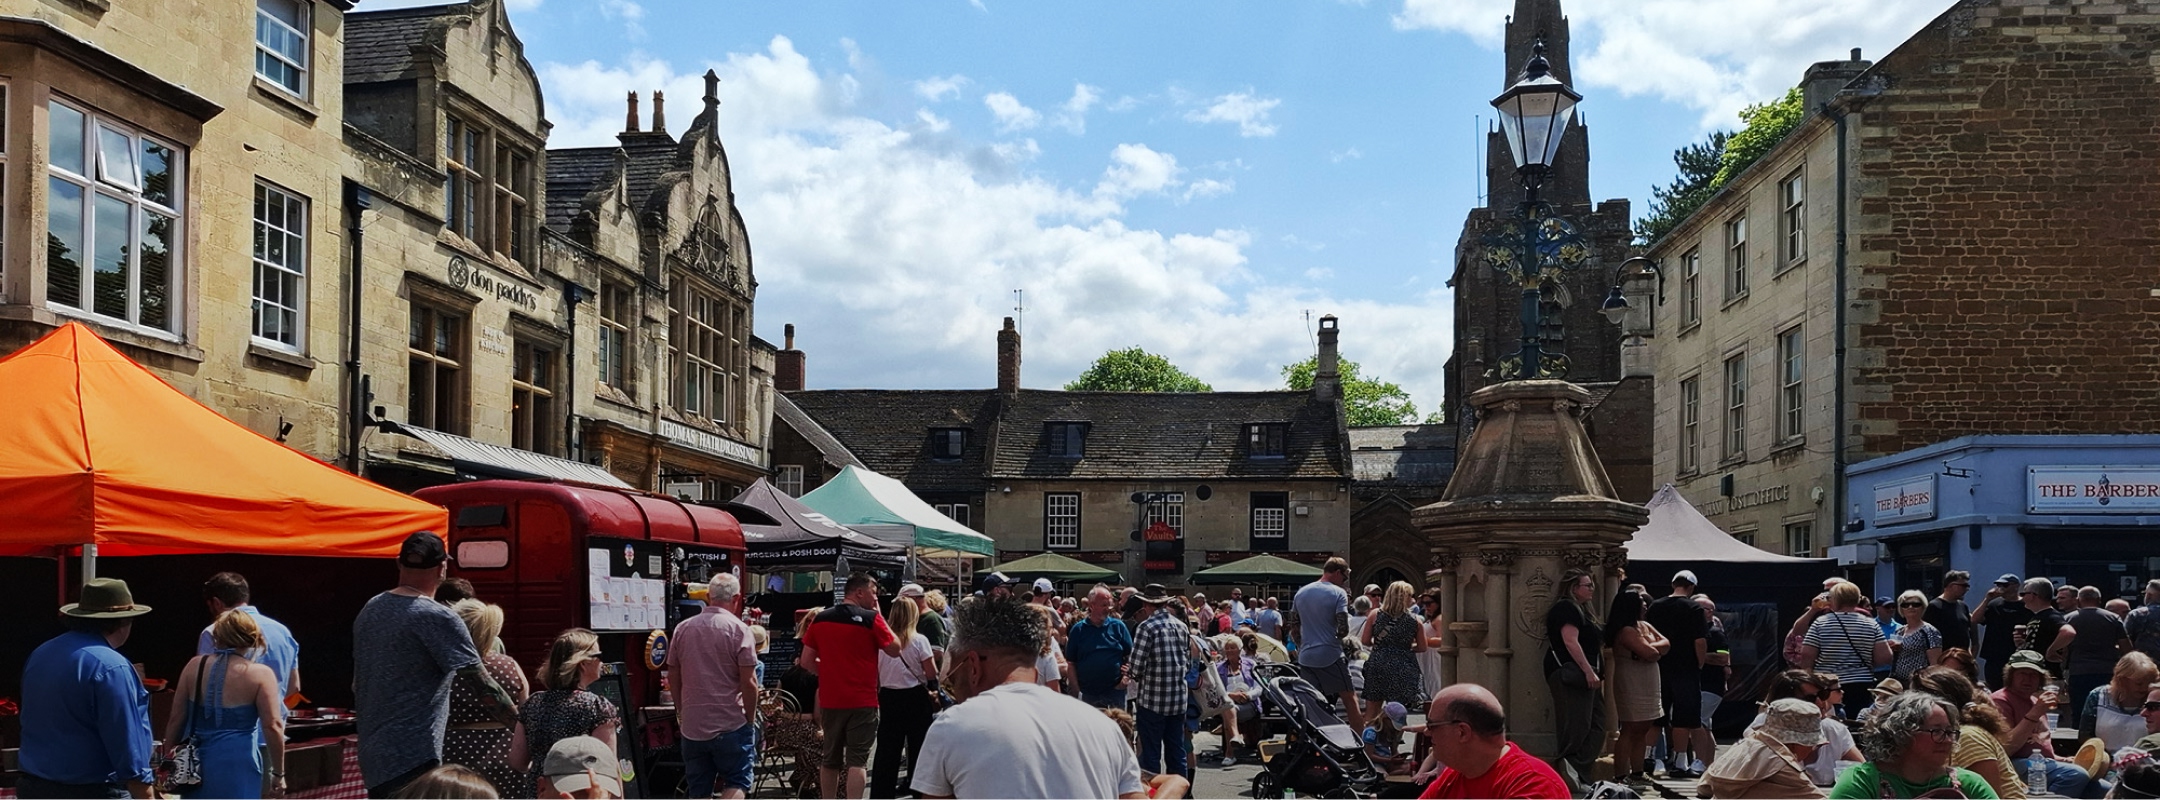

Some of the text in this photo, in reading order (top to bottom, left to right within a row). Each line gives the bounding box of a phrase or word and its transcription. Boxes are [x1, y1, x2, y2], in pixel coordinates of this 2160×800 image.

[471, 269, 536, 312] don paddy's
[660, 421, 757, 463] THOMAS HAIRDRESSING
[1753, 485, 1789, 506] OFFICE
[2038, 484, 2160, 498] THE BARBER
[1876, 492, 1929, 512] THE BARBERS
[1146, 531, 1175, 540] Vaults
[789, 548, 812, 557] POSH
[813, 548, 837, 556] DOGS
